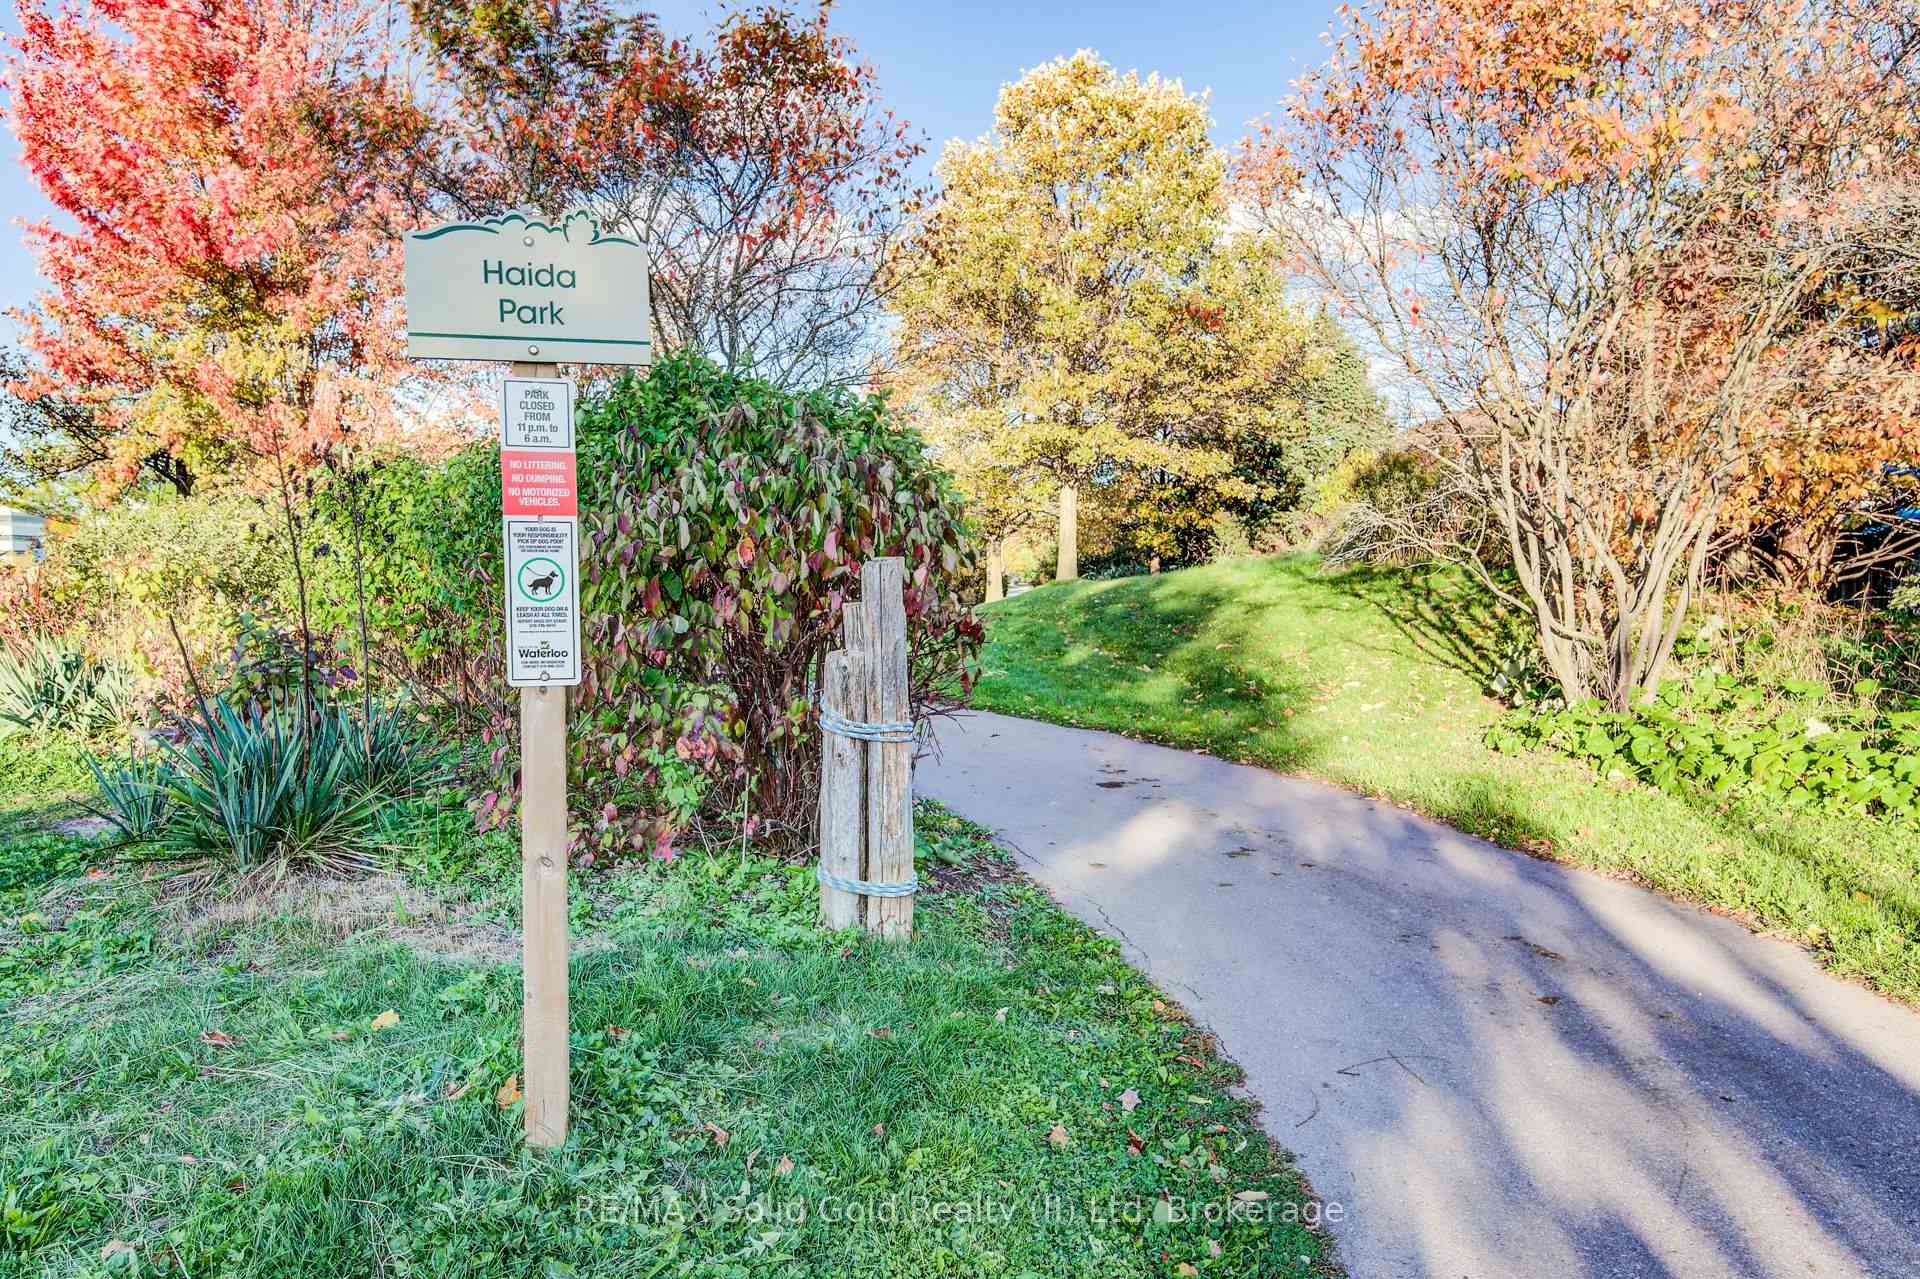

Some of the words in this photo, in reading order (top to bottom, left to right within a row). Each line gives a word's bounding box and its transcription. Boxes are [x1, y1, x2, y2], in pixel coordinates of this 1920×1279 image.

[483, 259, 577, 289] Haida
[499, 298, 565, 326] Park
[524, 390, 549, 400] PARK
[519, 400, 555, 411] CLOSED
[524, 412, 551, 422] FROM
[517, 423, 526, 432] 11
[528, 424, 549, 433] p.m.
[550, 424, 559, 433] to
[524, 434, 530, 443] 6
[532, 435, 552, 444] a.m.
[510, 460, 522, 469] NO
[511, 474, 523, 482] NO
[508, 487, 521, 497] NO
[522, 487, 570, 497] MOTORIZED
[519, 496, 560, 506] VEHICLES.
[518, 649, 568, 658] Waterloo
